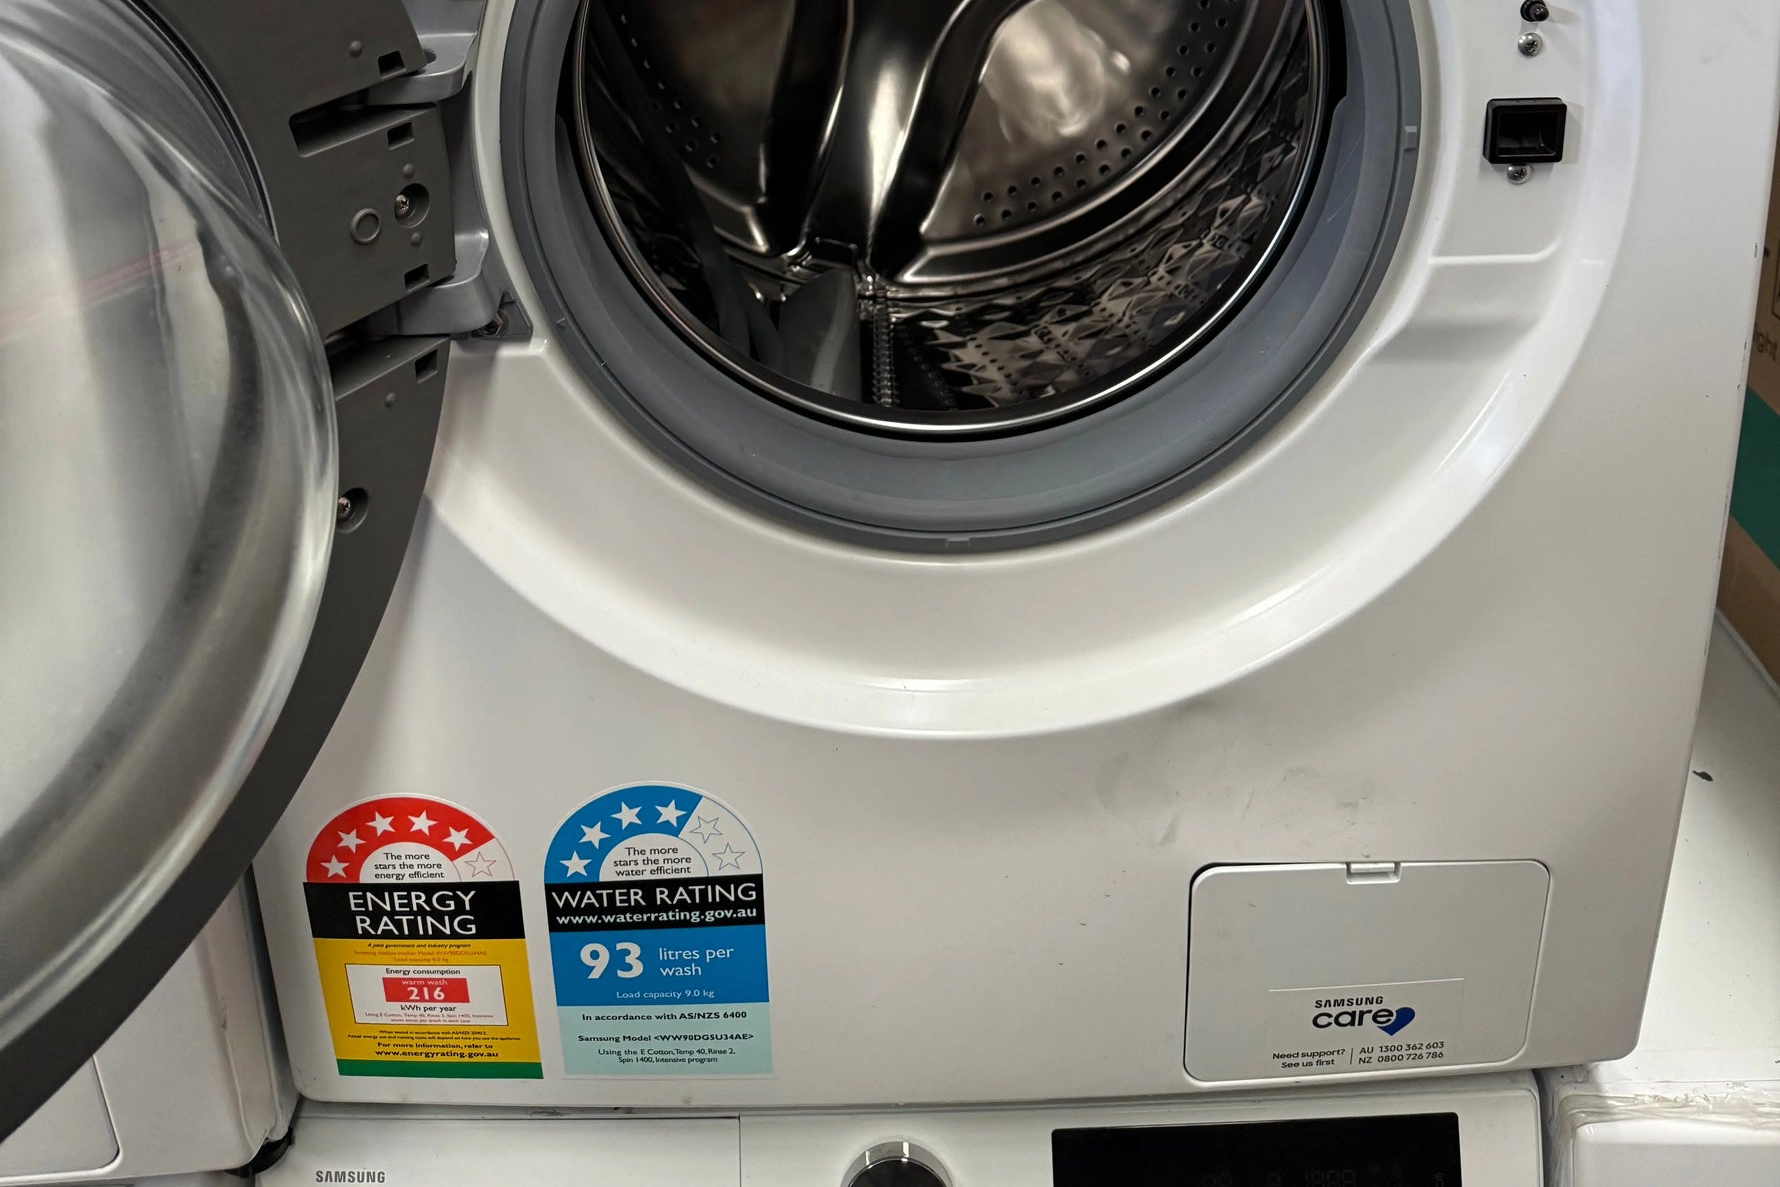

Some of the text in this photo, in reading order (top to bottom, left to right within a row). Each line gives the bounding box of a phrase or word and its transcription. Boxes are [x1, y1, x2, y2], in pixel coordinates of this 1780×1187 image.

[625, 847, 678, 856] The more
[642, 858, 660, 866] the
[375, 872, 405, 880] energy
[615, 866, 691, 877] water efficient
[349, 891, 476, 911] ENERGY
[552, 883, 756, 908] WATER RATING
[556, 908, 757, 925] www.waterrating.gov.au
[356, 916, 476, 934] RATING
[580, 942, 734, 979] 93 litres per
[660, 963, 701, 976] wash
[408, 987, 445, 1000] 216
[644, 991, 682, 999] capacity
[703, 990, 714, 998] kg
[1315, 996, 1383, 1008] SAMSUNG
[679, 1012, 721, 1020] AS/NZS
[1312, 1008, 1394, 1028] care
[578, 1035, 620, 1043] Samsung
[1405, 1043, 1423, 1051] 362
[598, 1049, 622, 1057] Using
[1301, 1049, 1345, 1059] support?
[1378, 1055, 1403, 1063] 0800
[1406, 1053, 1424, 1061] 726
[316, 1171, 385, 1183] SAMSUNG
